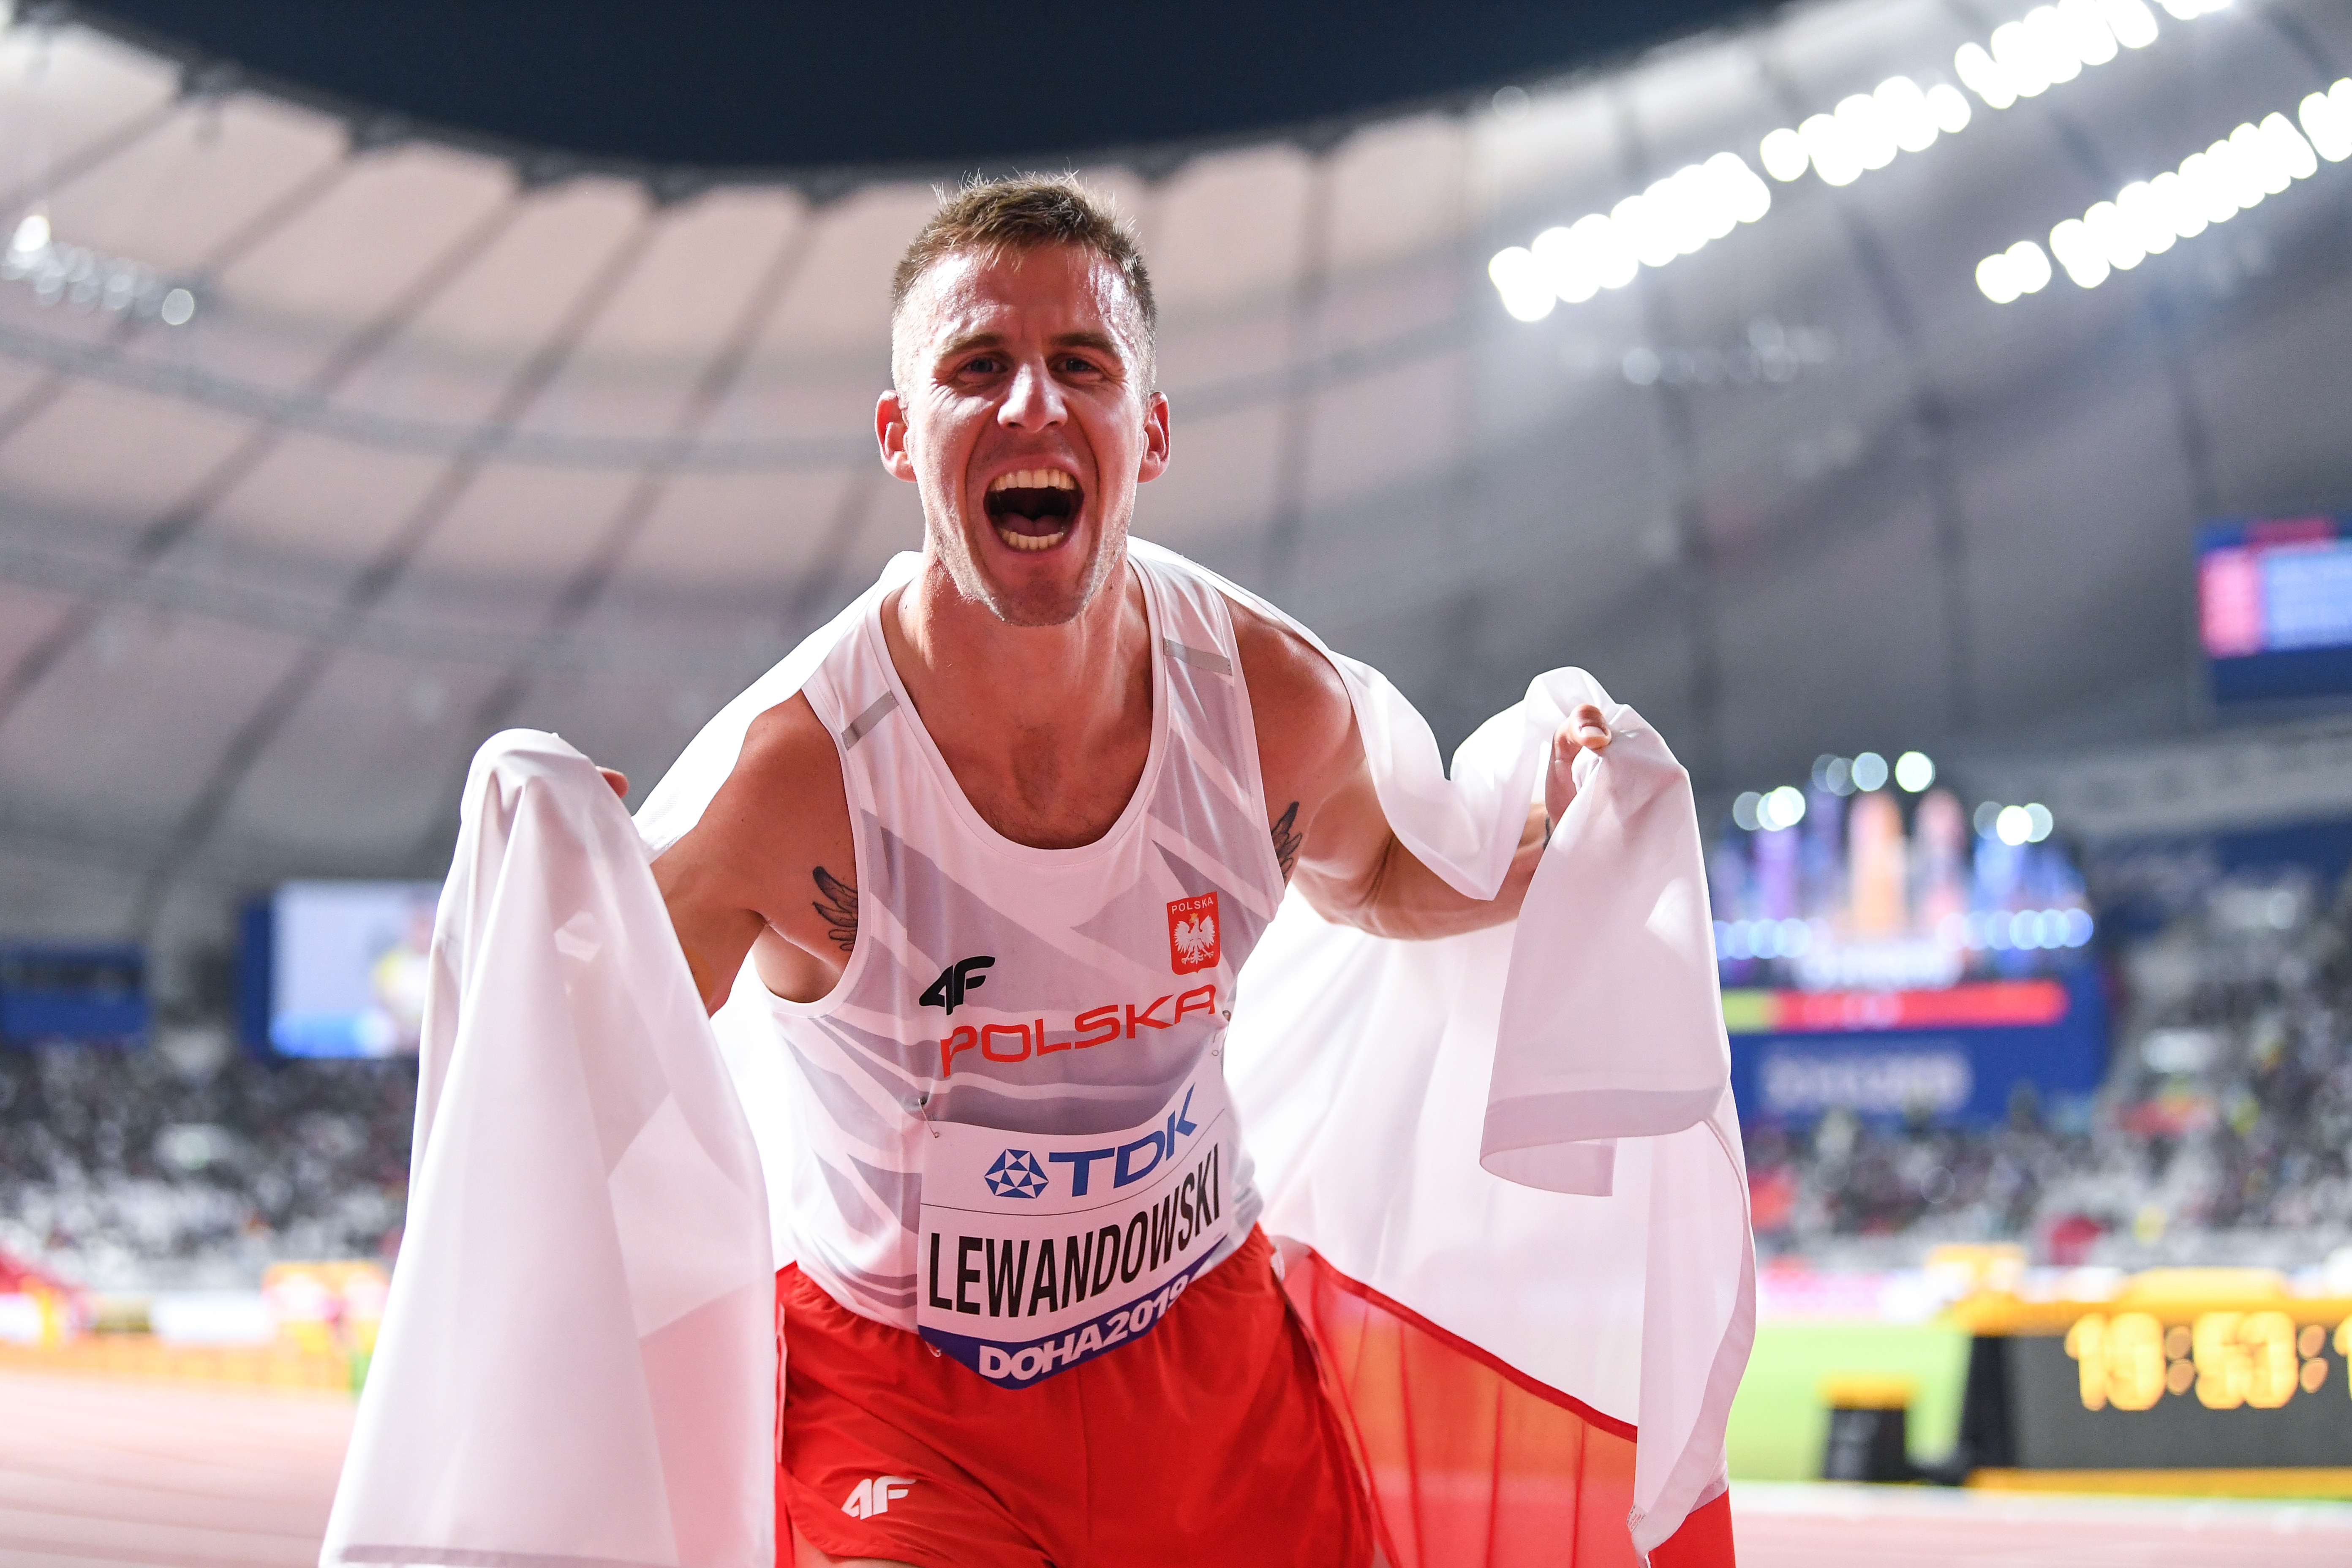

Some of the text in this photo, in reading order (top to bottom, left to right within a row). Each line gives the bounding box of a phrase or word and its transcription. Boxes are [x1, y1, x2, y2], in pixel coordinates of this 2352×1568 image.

[1171, 896, 1214, 915] POLSKA
[919, 956, 996, 1016] 4F
[940, 984, 1217, 1078] POLSKA
[1048, 1083, 1198, 1197] TDK
[929, 1142, 1221, 1318] LEWANDOWSKI
[841, 1475, 917, 1520] 4F
